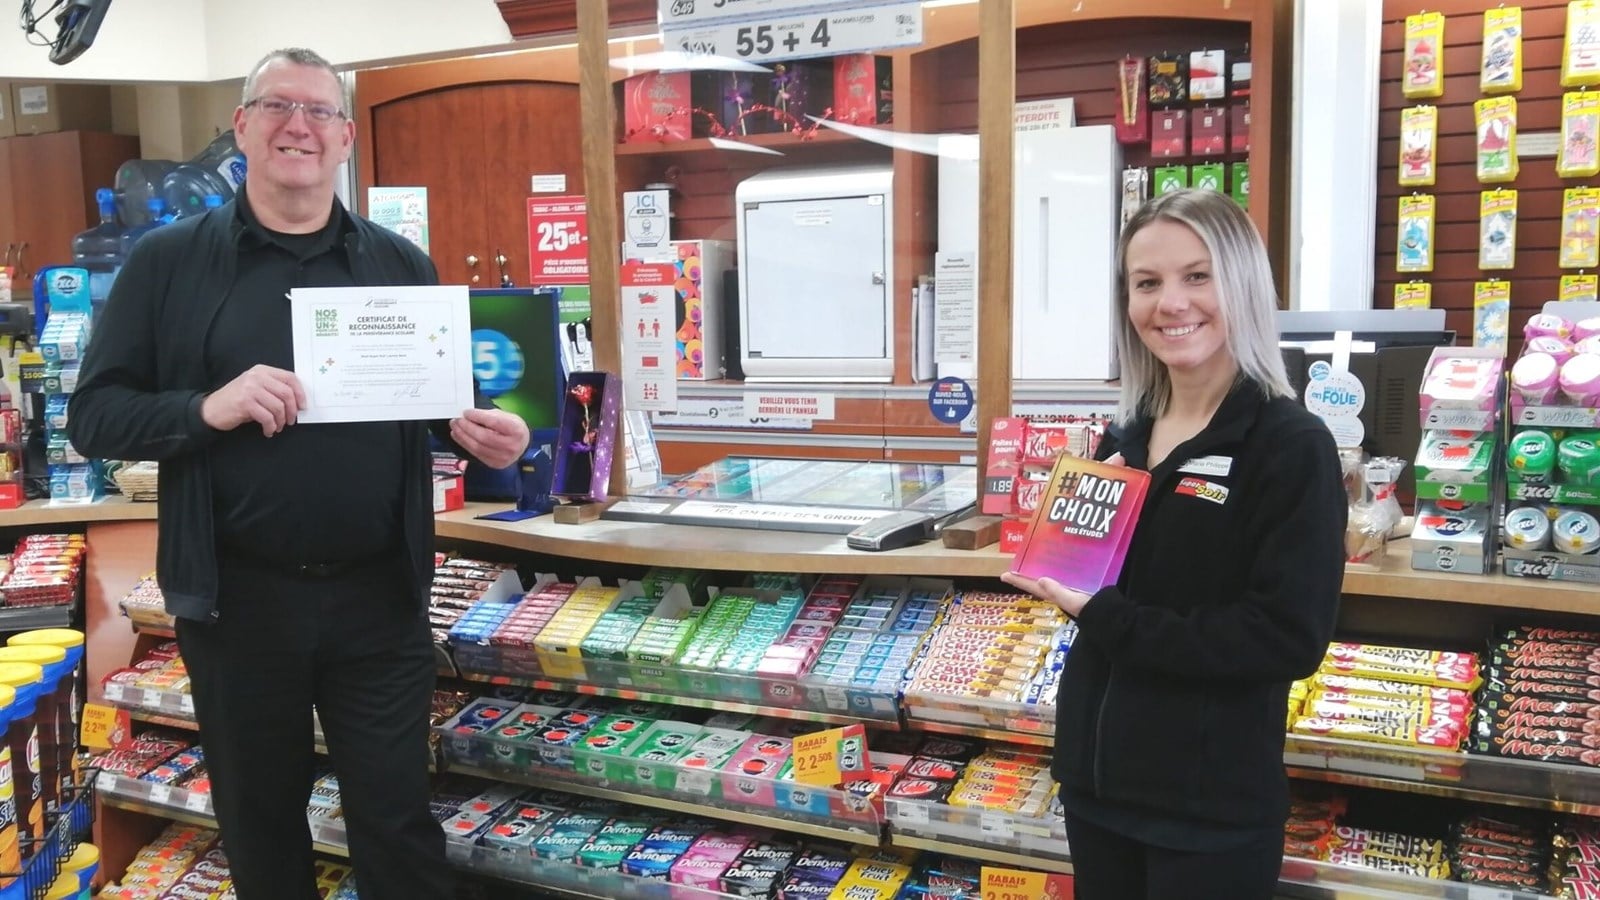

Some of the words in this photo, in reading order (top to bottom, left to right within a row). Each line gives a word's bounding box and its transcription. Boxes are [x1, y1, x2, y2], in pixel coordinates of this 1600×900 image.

[737, 25, 774, 56] 55
[811, 18, 831, 48] 4
[637, 194, 655, 208] ICI
[537, 221, 569, 252] 25
[569, 230, 580, 245] et
[349, 322, 417, 331] RECONNAISSANCE
[475, 341, 499, 380] 5
[759, 397, 783, 405] VEUILLEZ
[784, 397, 800, 405] VOUS
[800, 397, 817, 405] TENIR
[758, 406, 785, 414] DERRIÈRE
[785, 406, 791, 414] LE
[792, 406, 818, 415] PANNEAU
[1057, 471, 1127, 506] #MON
[1516, 484, 1562, 502] excel
[1049, 497, 1117, 534] CHOIX
[1064, 526, 1079, 536] MES
[1078, 527, 1104, 539] ÉTUDES
[1513, 560, 1559, 579] excel
[1519, 640, 1584, 653] Mars
[1513, 655, 1578, 667] Mars
[929, 672, 973, 684] CRISP
[1510, 667, 1577, 680] Mars
[1511, 680, 1578, 693] Mars
[1509, 696, 1577, 713] Mas
[1504, 710, 1572, 727] Mars
[797, 736, 828, 749] RABAIS
[1500, 739, 1570, 757] Mars
[798, 757, 806, 771] 2
[556, 817, 602, 826] Dentyne
[601, 825, 647, 834] Dentyne
[537, 836, 584, 845] Dentyne
[646, 833, 694, 842] Dentyne
[580, 844, 628, 852] Dentyne
[696, 840, 743, 849] Dentyne
[627, 851, 677, 861] Dentyne
[743, 849, 794, 859] Dentyne
[678, 859, 727, 868] Dentyne
[796, 857, 847, 868] Dentyne
[725, 868, 777, 878] Dentyne
[987, 874, 1027, 886] RABAIS
[784, 884, 835, 895] Dentyne
